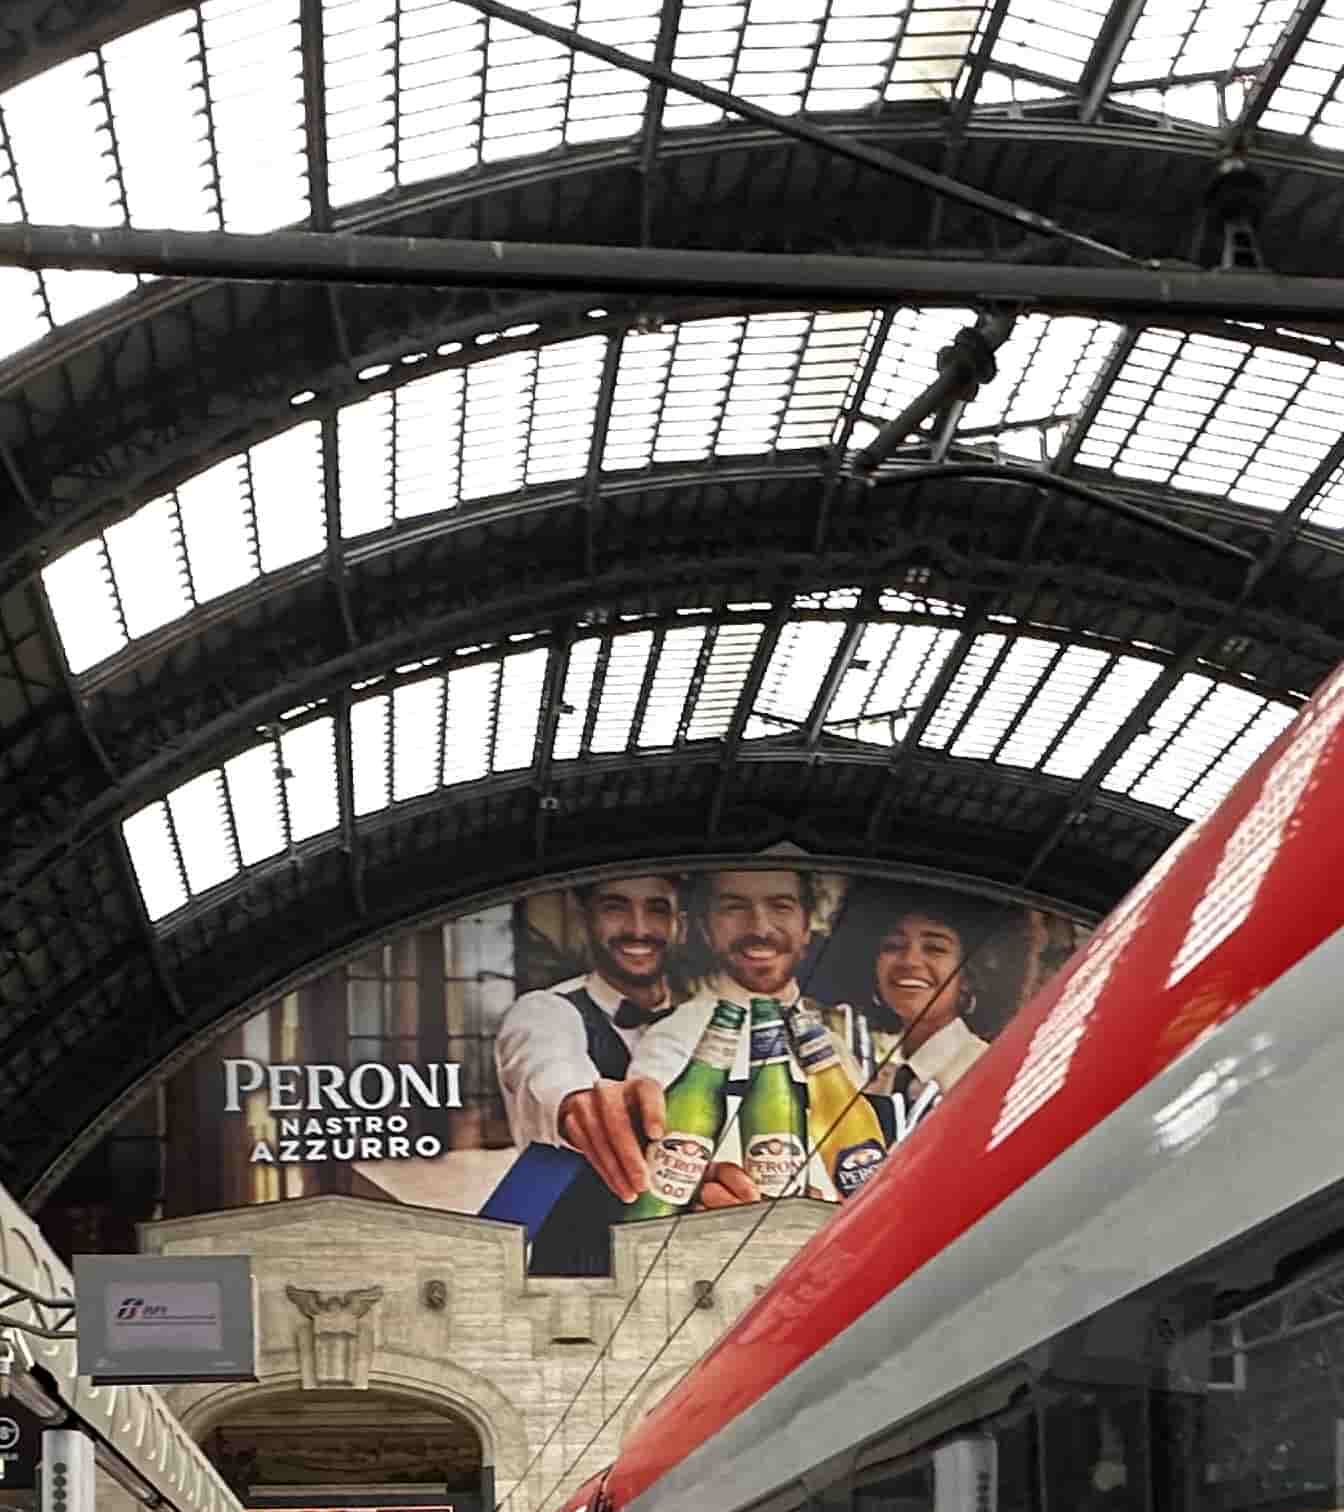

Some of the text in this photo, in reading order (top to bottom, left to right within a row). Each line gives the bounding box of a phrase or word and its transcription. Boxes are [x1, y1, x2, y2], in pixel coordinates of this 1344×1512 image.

[223, 1059, 464, 1112] PERONI
[280, 1115, 408, 1136] NASTRO
[250, 1135, 442, 1163] AZZURRO
